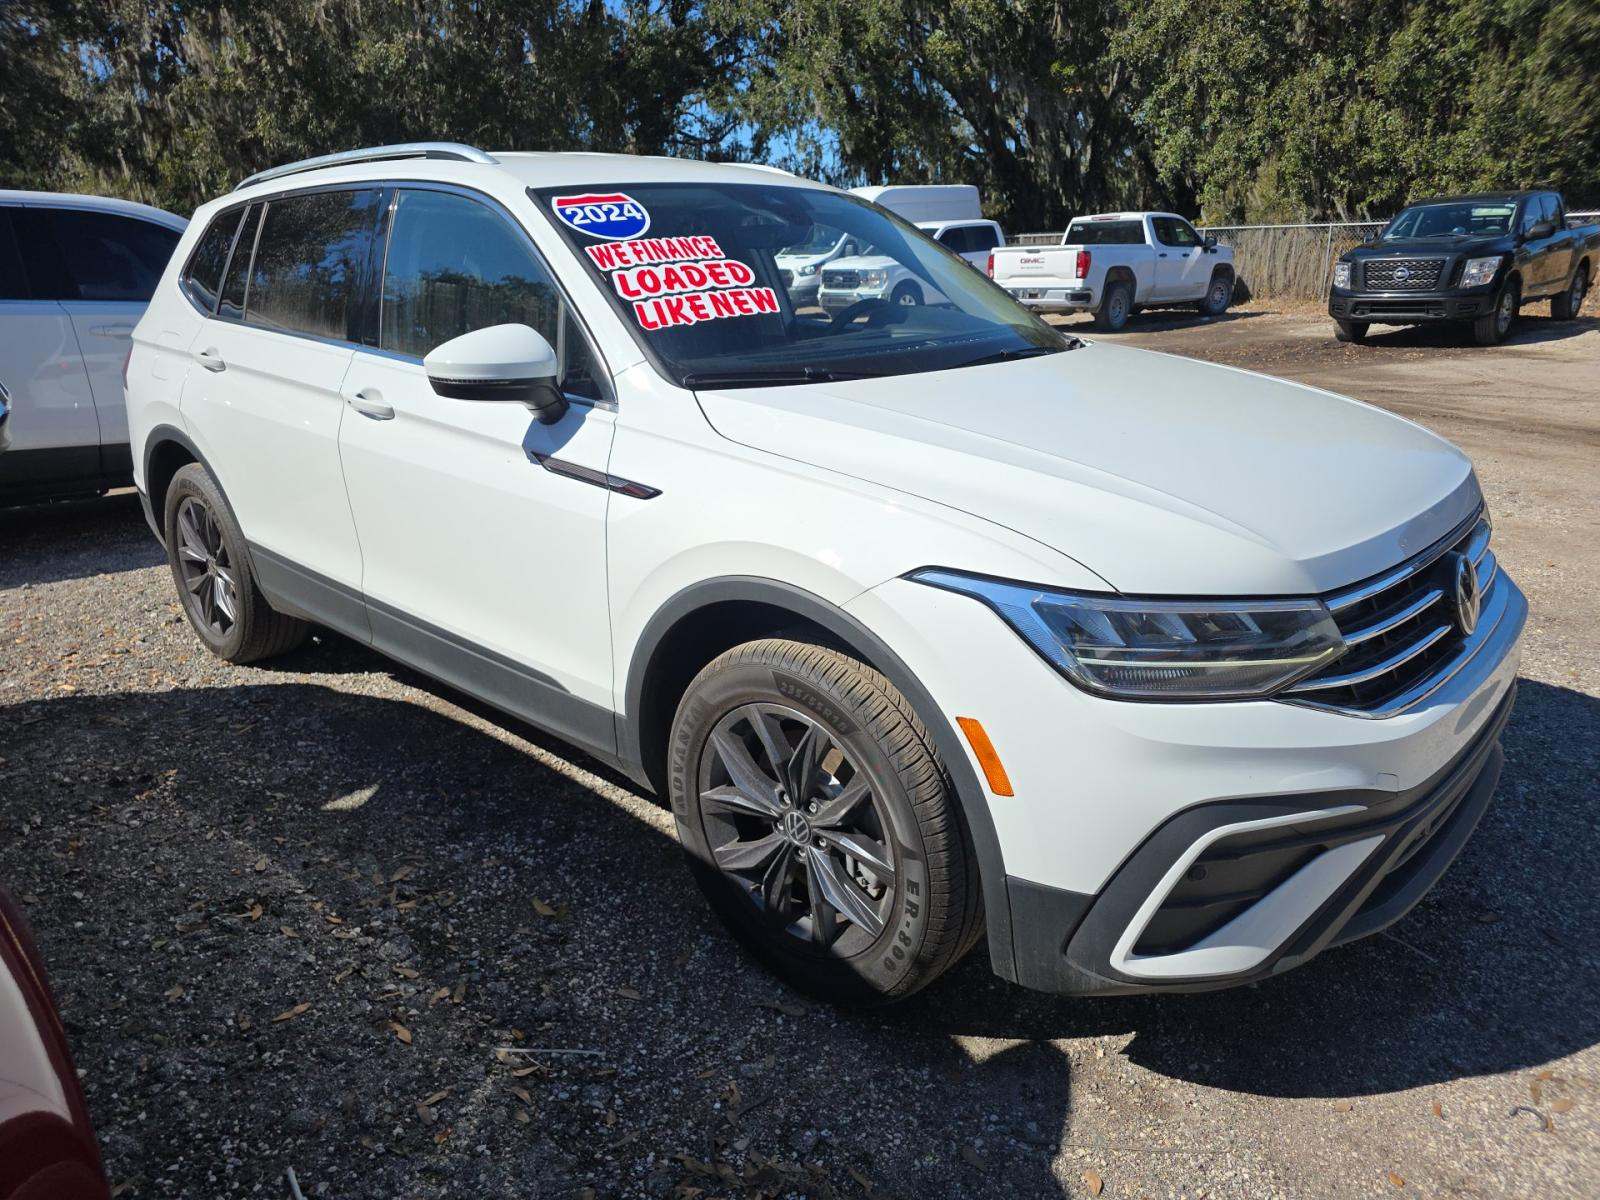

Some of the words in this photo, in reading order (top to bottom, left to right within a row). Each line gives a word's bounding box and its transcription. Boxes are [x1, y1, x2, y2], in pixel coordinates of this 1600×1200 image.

[565, 203, 642, 226] 2024
[587, 242, 629, 270] WE
[628, 236, 724, 265] FINANCE
[617, 263, 751, 299] LOADED
[635, 294, 709, 330] LIKE
[709, 289, 778, 317] NEW
